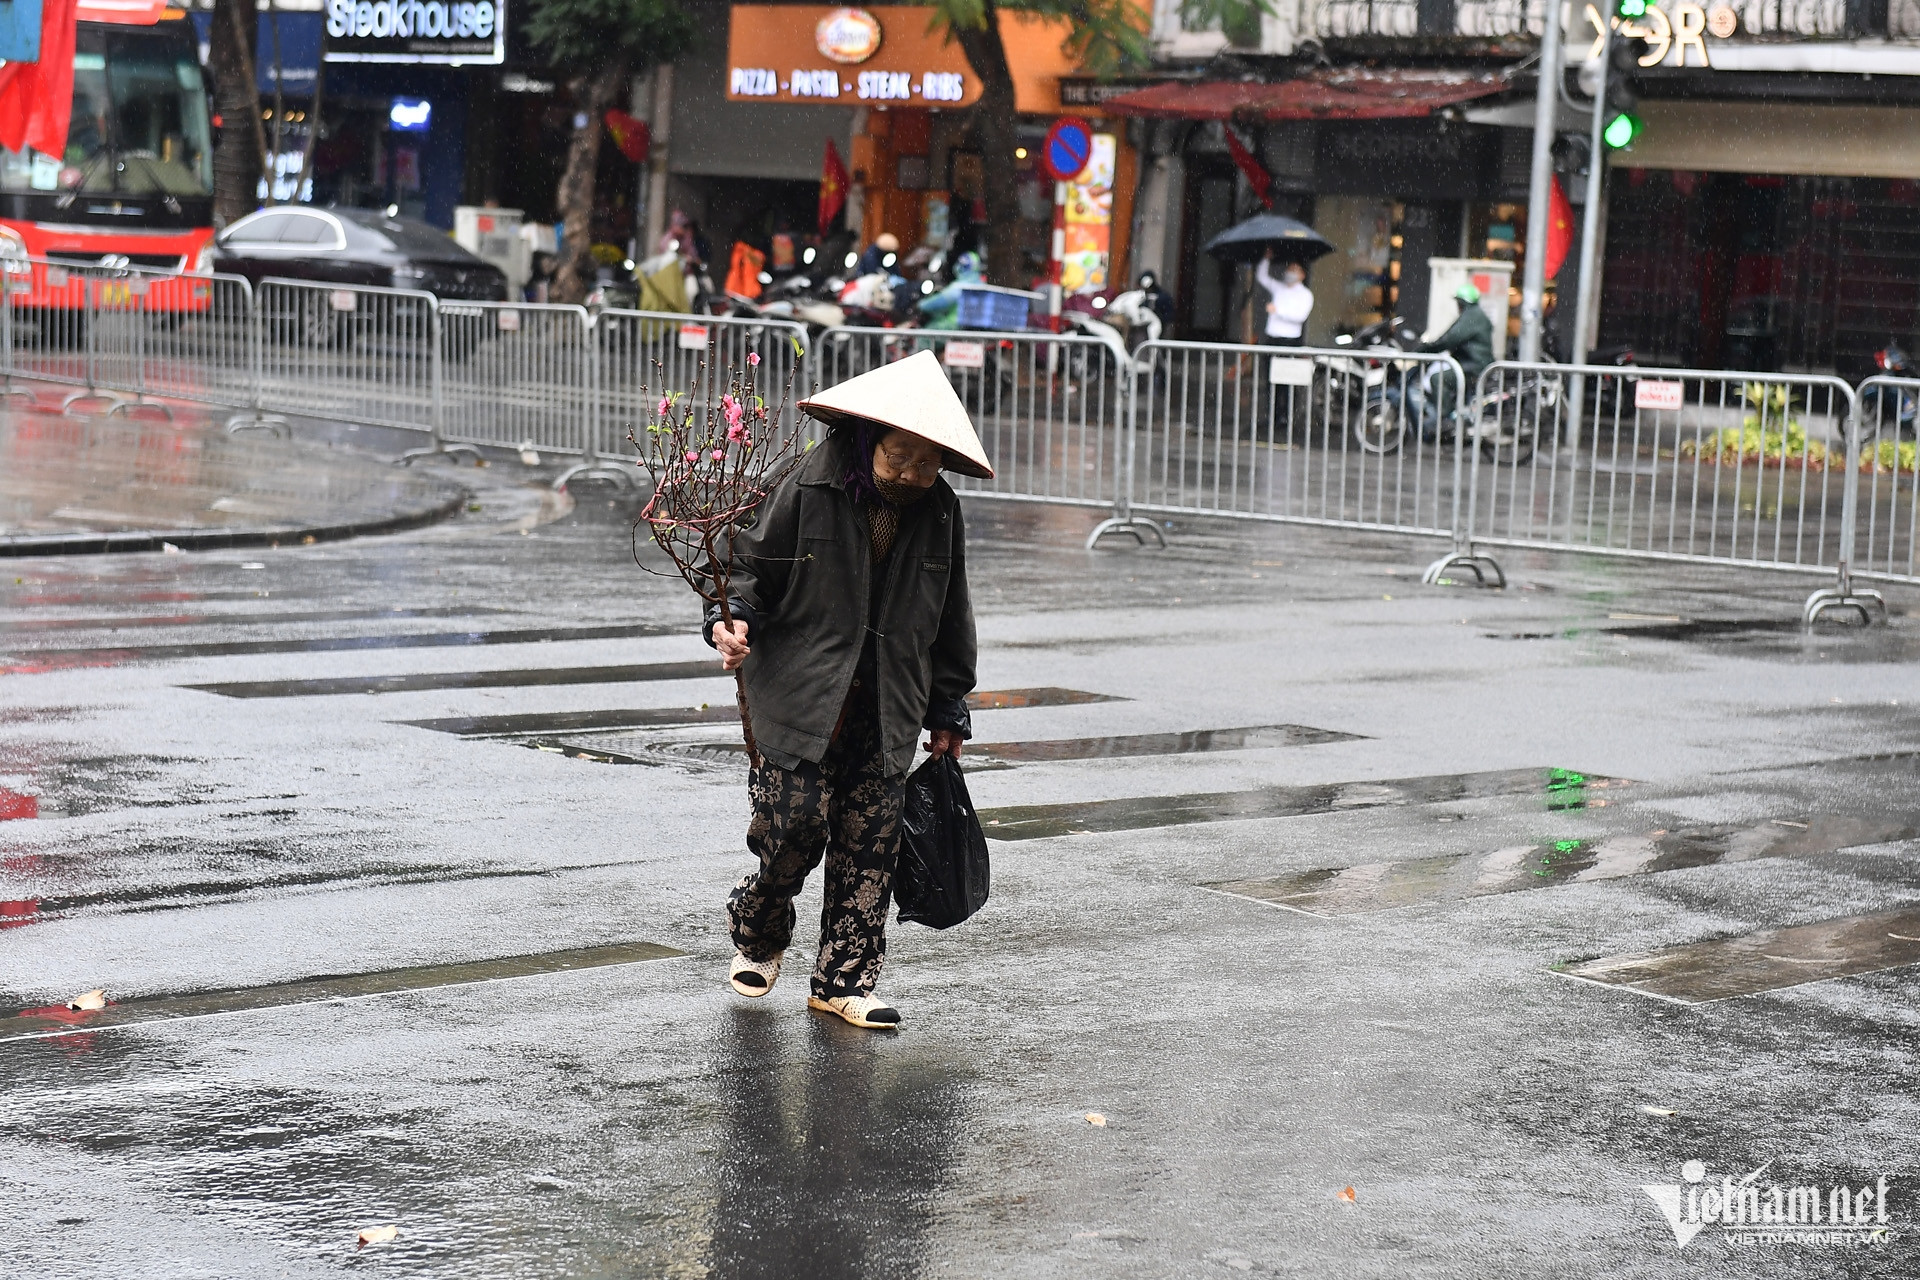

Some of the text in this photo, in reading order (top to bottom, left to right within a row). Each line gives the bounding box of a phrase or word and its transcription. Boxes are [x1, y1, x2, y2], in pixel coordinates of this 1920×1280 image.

[731, 67, 778, 96] PIZZA
[791, 69, 840, 98] PASTA
[857, 70, 911, 100] STEAK
